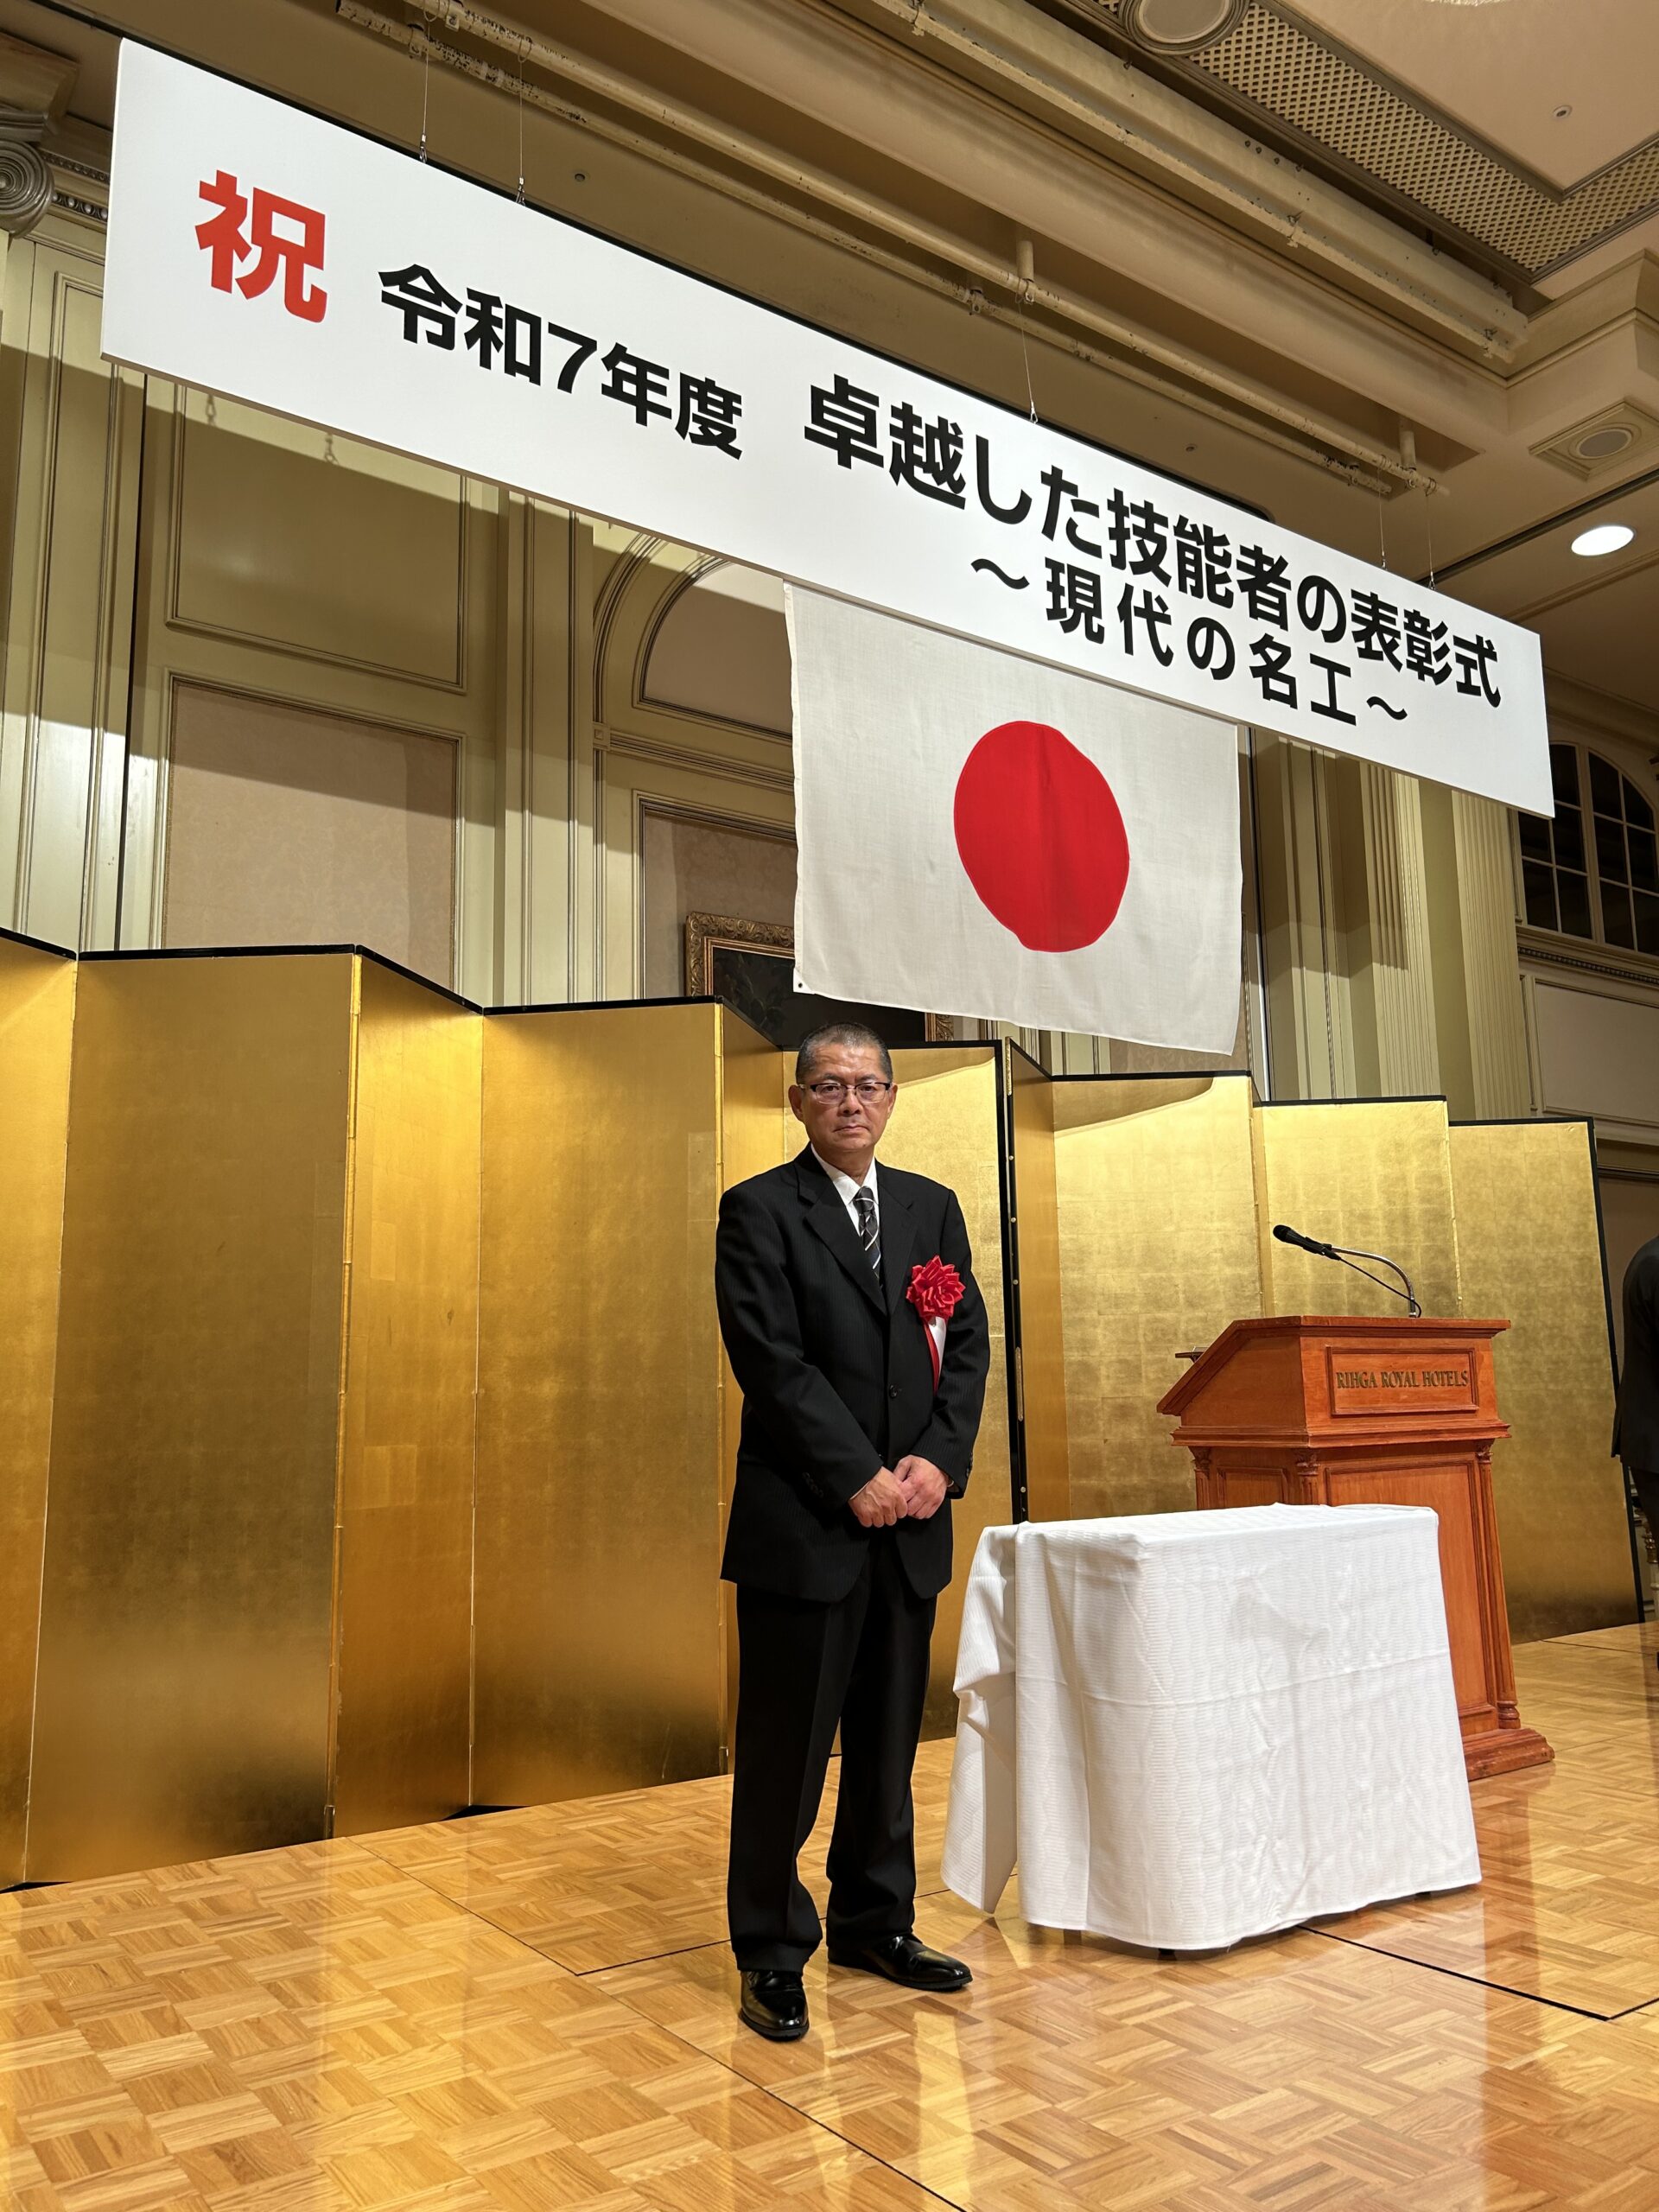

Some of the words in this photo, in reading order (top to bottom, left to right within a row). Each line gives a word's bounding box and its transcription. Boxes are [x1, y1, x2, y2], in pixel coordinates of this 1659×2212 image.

[195, 170, 327, 323] 祝
[378, 264, 742, 460] 令和7年度
[804, 374, 1502, 709] 卓越した技能者の表彰式
[1336, 1371, 1377, 1389] RIHGA
[1381, 1370, 1420, 1388] ROYAL
[1422, 1370, 1468, 1387] HOTELS
